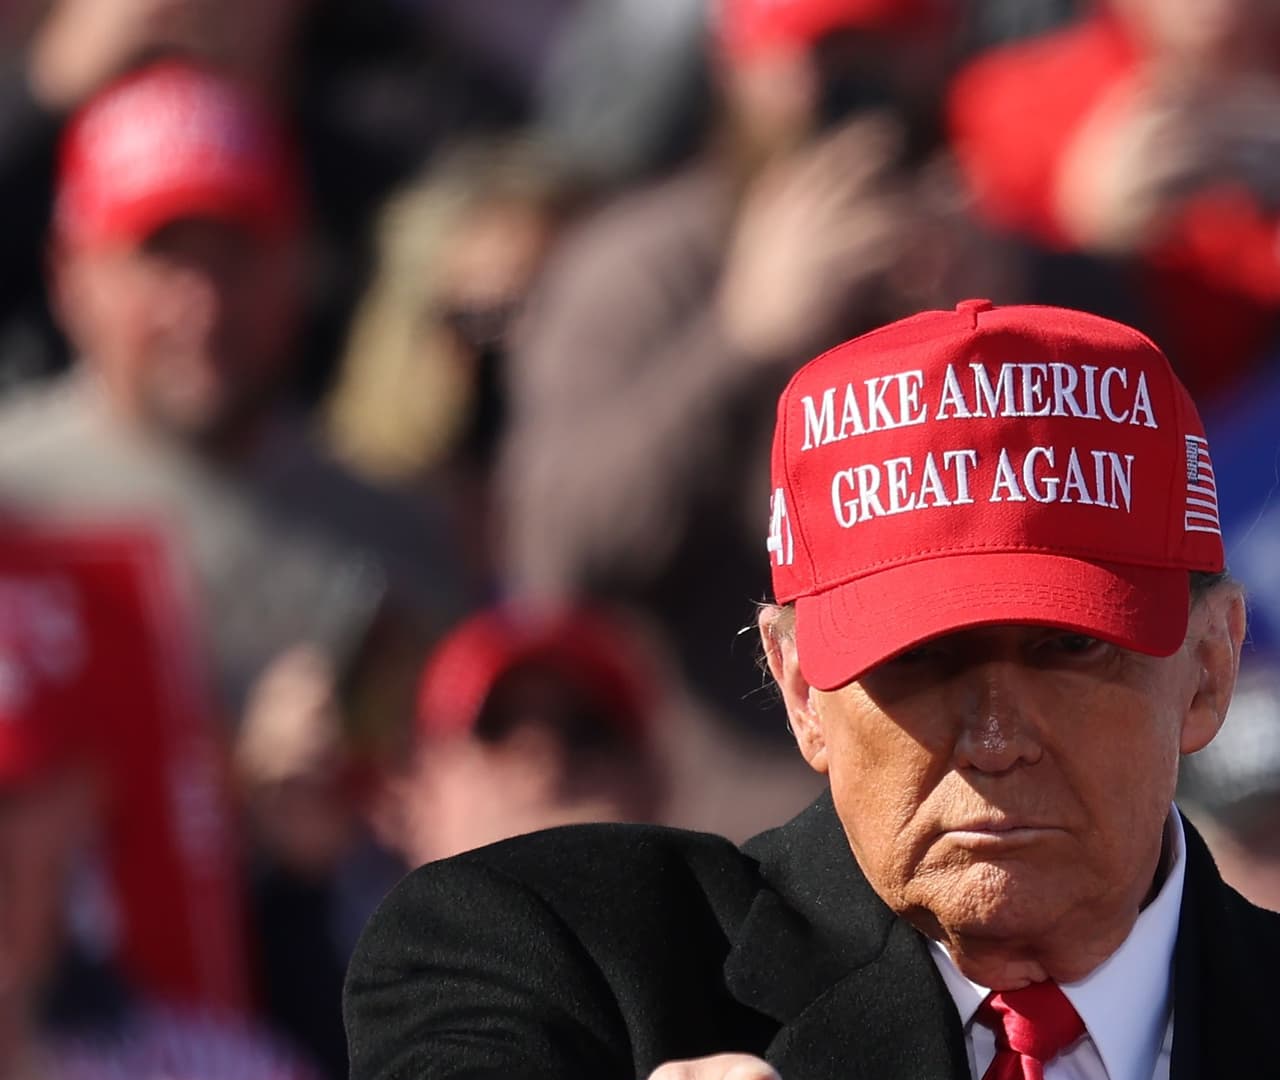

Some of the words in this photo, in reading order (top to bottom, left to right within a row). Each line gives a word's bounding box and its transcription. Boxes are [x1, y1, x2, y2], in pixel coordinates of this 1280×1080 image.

[801, 369, 926, 451] MAKE
[935, 363, 1158, 430] AMERICA
[831, 449, 977, 529] GREAT
[989, 446, 1135, 513] AGAIN
